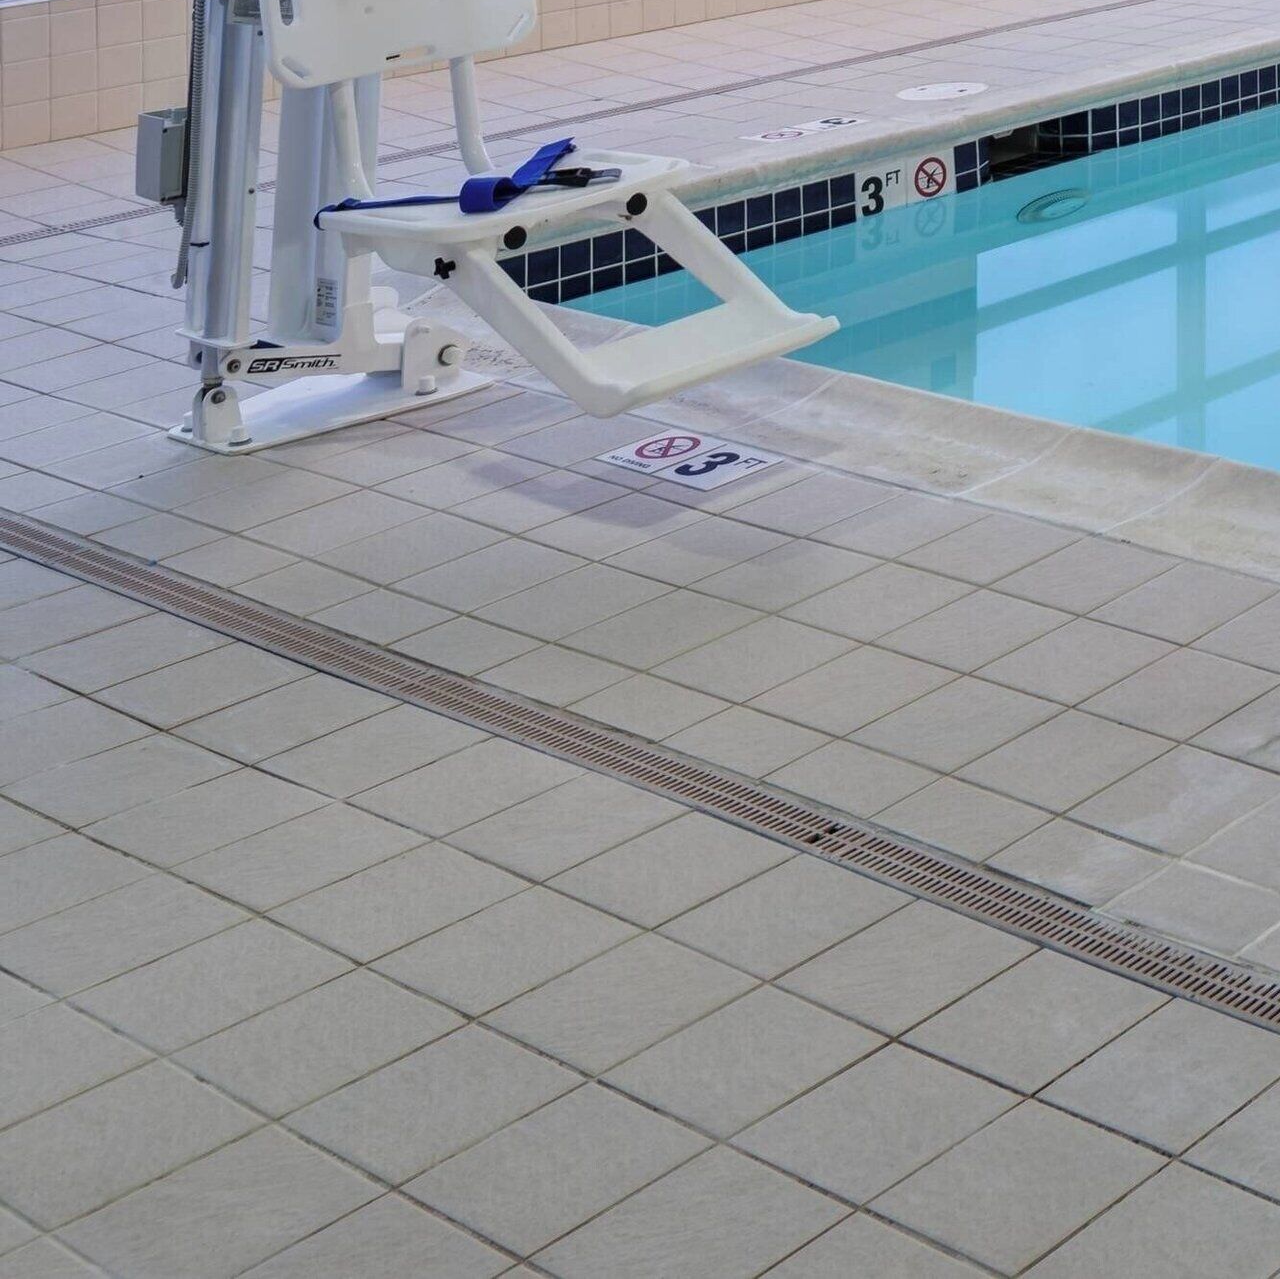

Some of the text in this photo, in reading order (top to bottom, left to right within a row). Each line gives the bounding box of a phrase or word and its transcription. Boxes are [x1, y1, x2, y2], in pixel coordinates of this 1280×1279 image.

[861, 169, 901, 216] 3 FT
[674, 452, 768, 476] 3 FT
